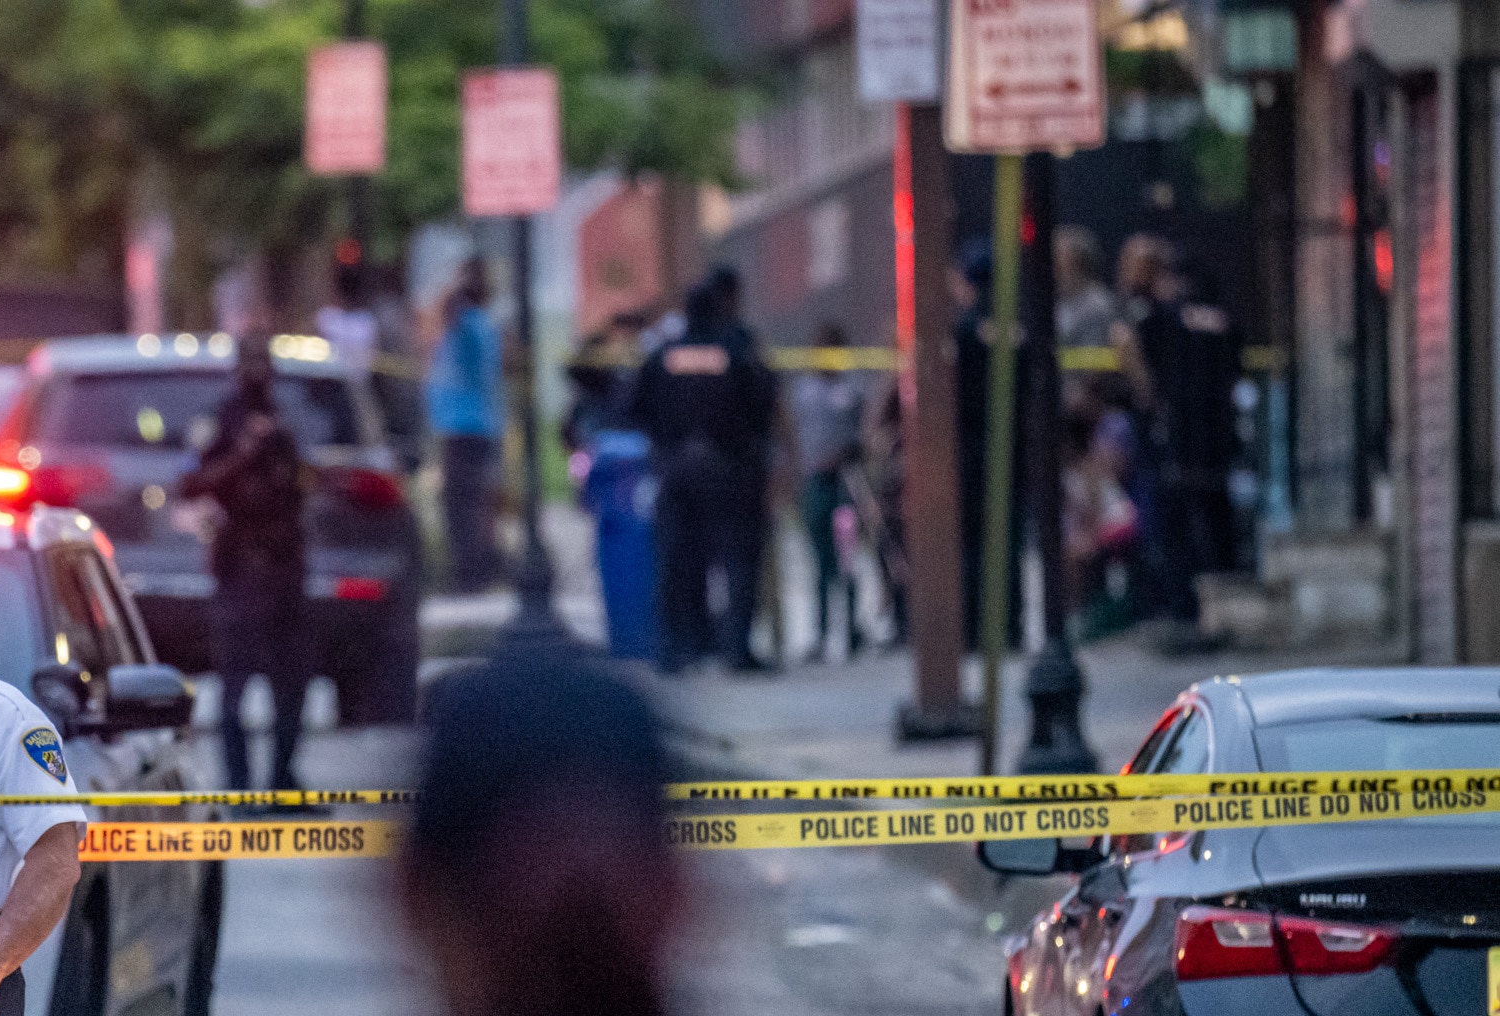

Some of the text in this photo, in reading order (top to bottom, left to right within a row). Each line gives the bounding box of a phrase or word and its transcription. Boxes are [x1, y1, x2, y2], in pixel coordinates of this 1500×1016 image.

[1208, 779, 1318, 796] POLICE
[1331, 777, 1400, 794] LINE
[1411, 777, 1452, 793] DO
[1173, 788, 1487, 825] POLICE LINE DO NOT CROSS
[146, 829, 193, 853] LINE
[203, 829, 231, 853] DO
[241, 828, 284, 852] NOT
[294, 826, 365, 852] CROSS
[666, 806, 1109, 844] CROSS POLICE LINE DO NOT CROSS
